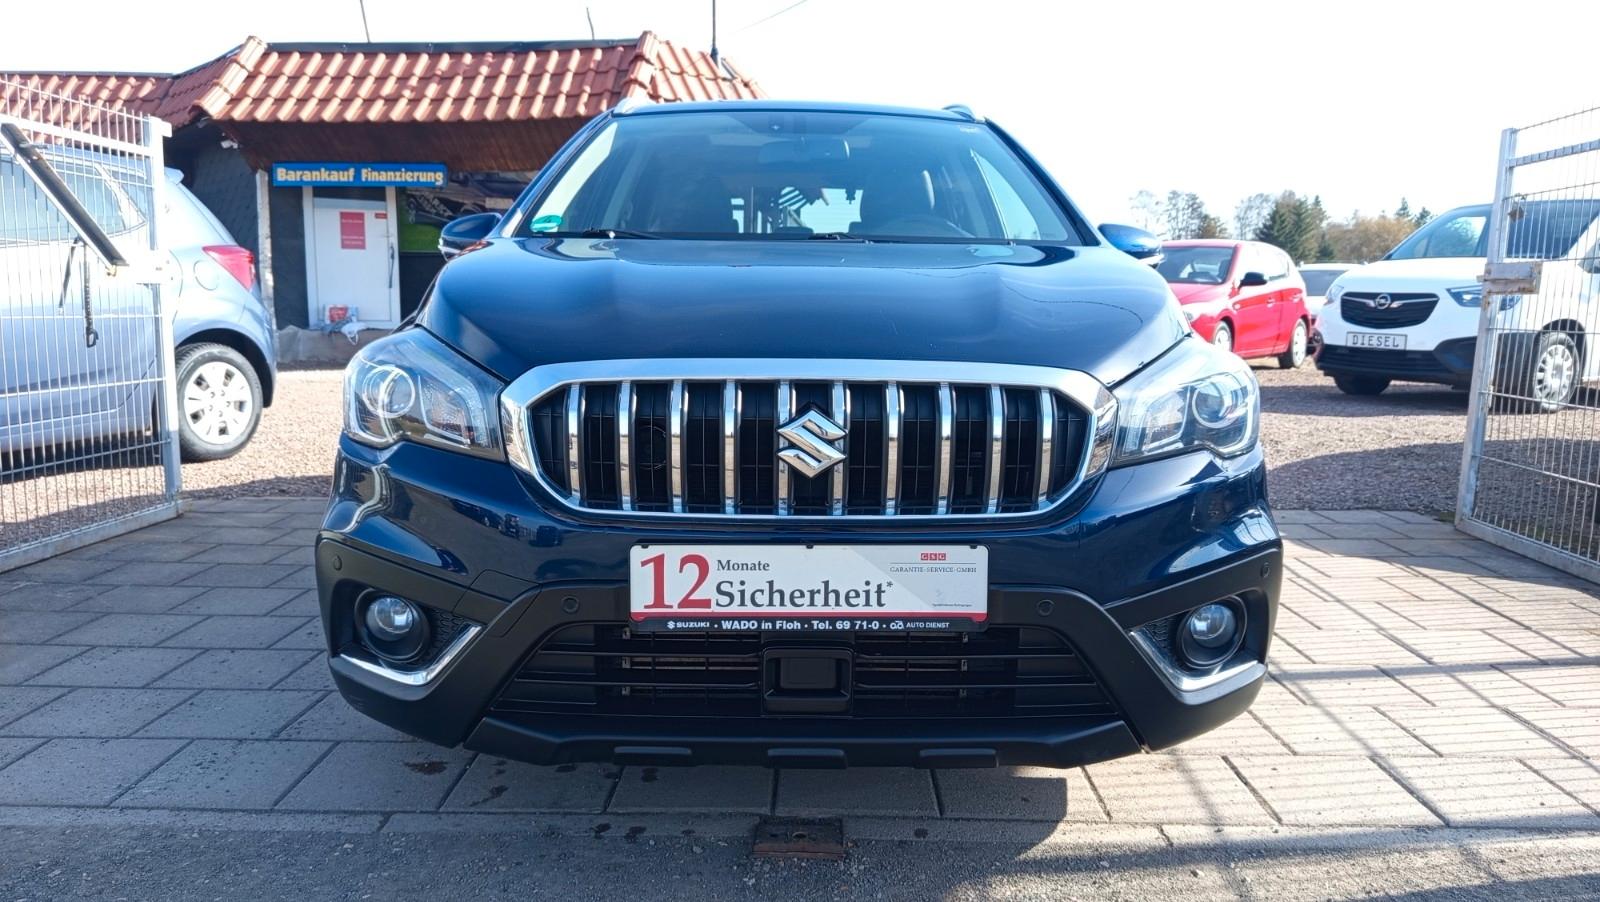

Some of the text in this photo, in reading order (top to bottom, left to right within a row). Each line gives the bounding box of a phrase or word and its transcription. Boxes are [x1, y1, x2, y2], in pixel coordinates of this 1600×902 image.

[276, 168, 444, 186] Barankauf Finanzierung
[1352, 335, 1399, 347] DIESEL
[717, 559, 770, 571] Monate
[640, 552, 712, 609] 12
[721, 620, 758, 630] WADO
[761, 620, 773, 629] in
[775, 620, 801, 630] Floh
[811, 620, 833, 630] Tel.
[835, 620, 851, 630] 69
[854, 620, 880, 630] 71-0
